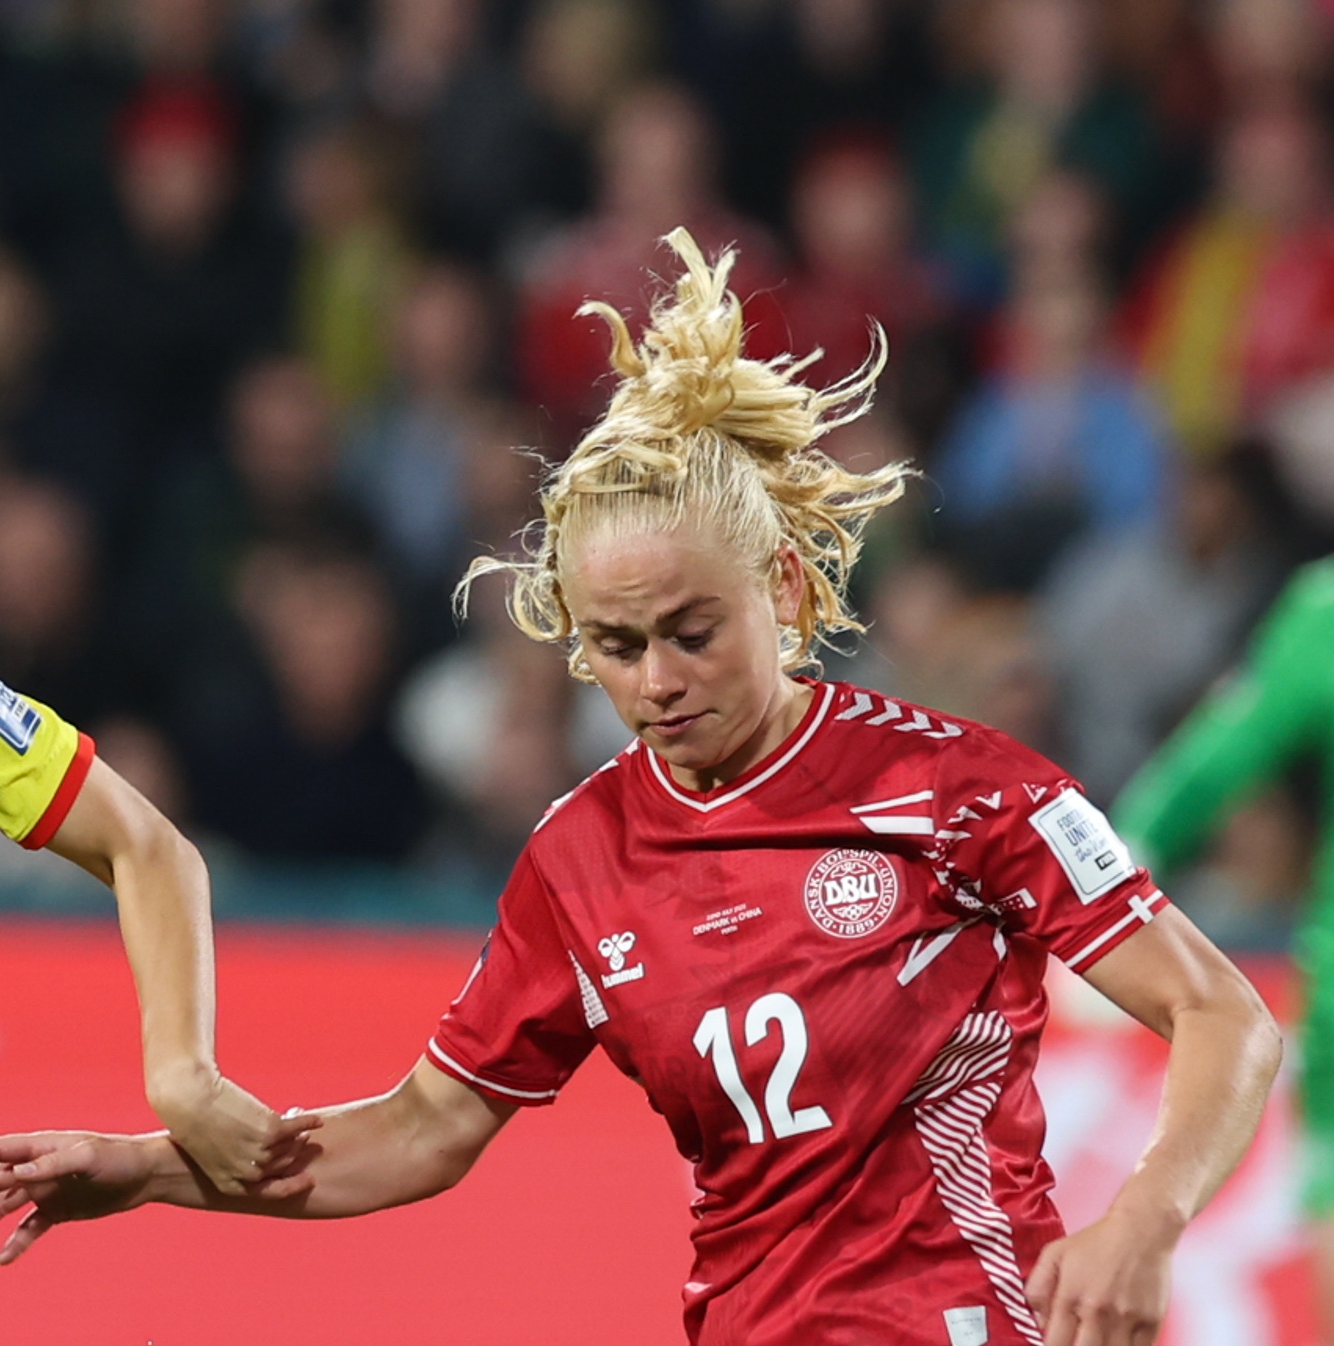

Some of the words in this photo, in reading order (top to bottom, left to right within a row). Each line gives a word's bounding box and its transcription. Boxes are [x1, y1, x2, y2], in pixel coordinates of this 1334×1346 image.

[1065, 820, 1100, 847] UNITE
[808, 877, 834, 929] DANSK
[876, 867, 894, 918] UNION
[823, 873, 879, 906] DBU
[692, 917, 730, 936] DENMARK
[738, 906, 763, 921] CHINA
[693, 992, 832, 1144] 12
